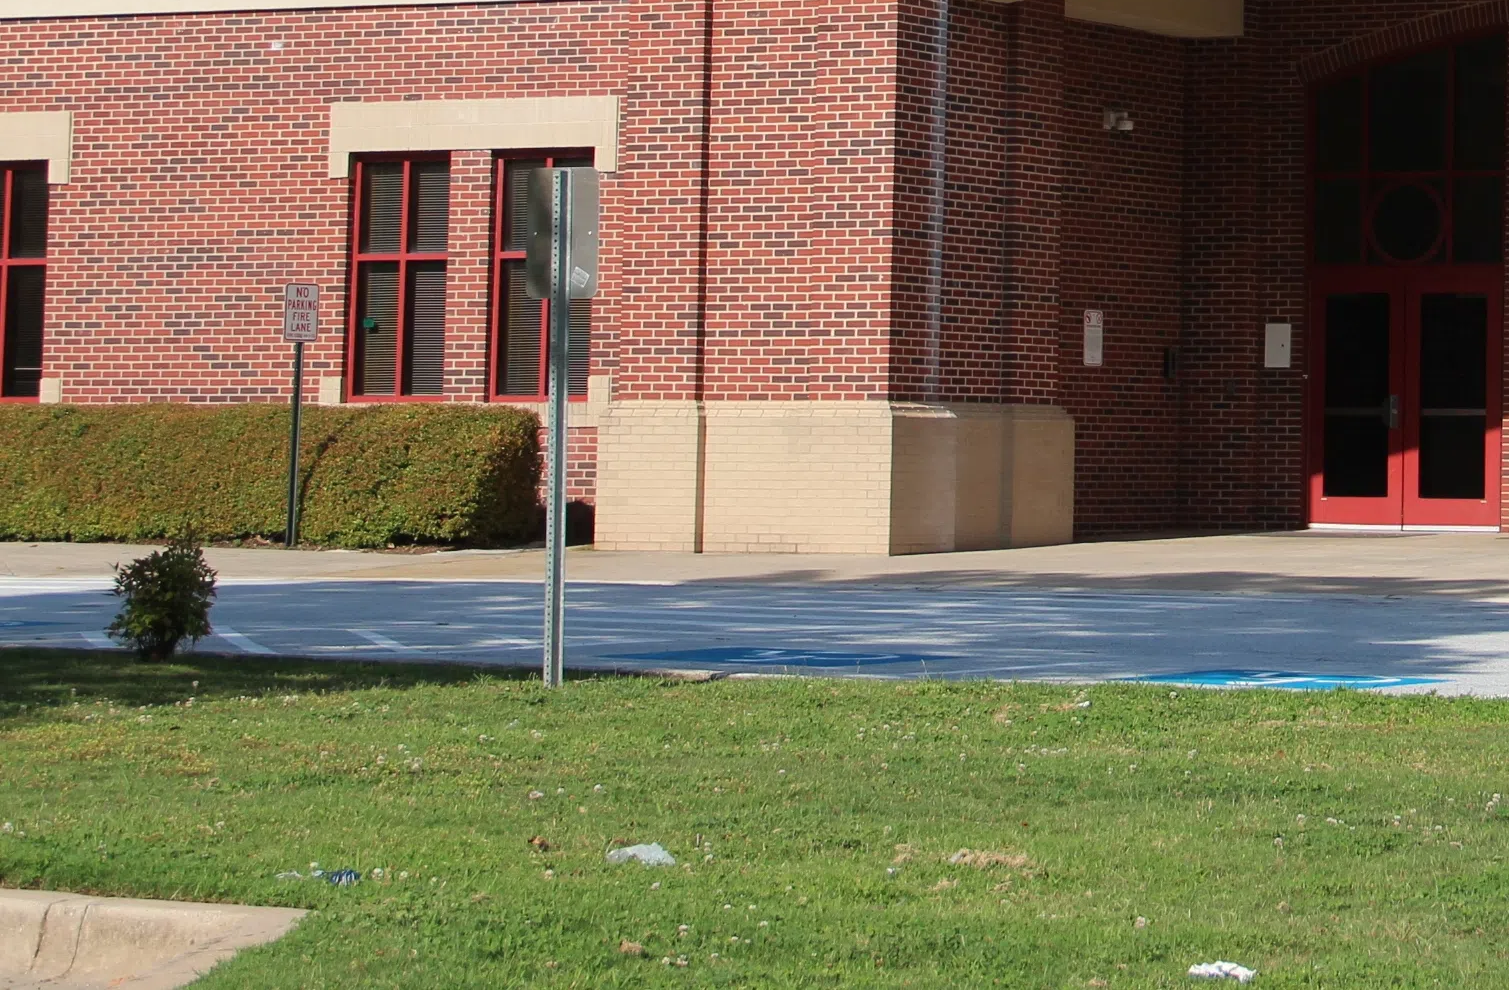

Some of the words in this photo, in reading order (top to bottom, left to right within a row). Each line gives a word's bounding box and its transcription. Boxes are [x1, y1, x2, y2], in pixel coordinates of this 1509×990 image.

[296, 287, 309, 298] NO
[288, 300, 317, 311] PARKING
[292, 312, 311, 321] FIRE
[291, 323, 312, 332] LANE
